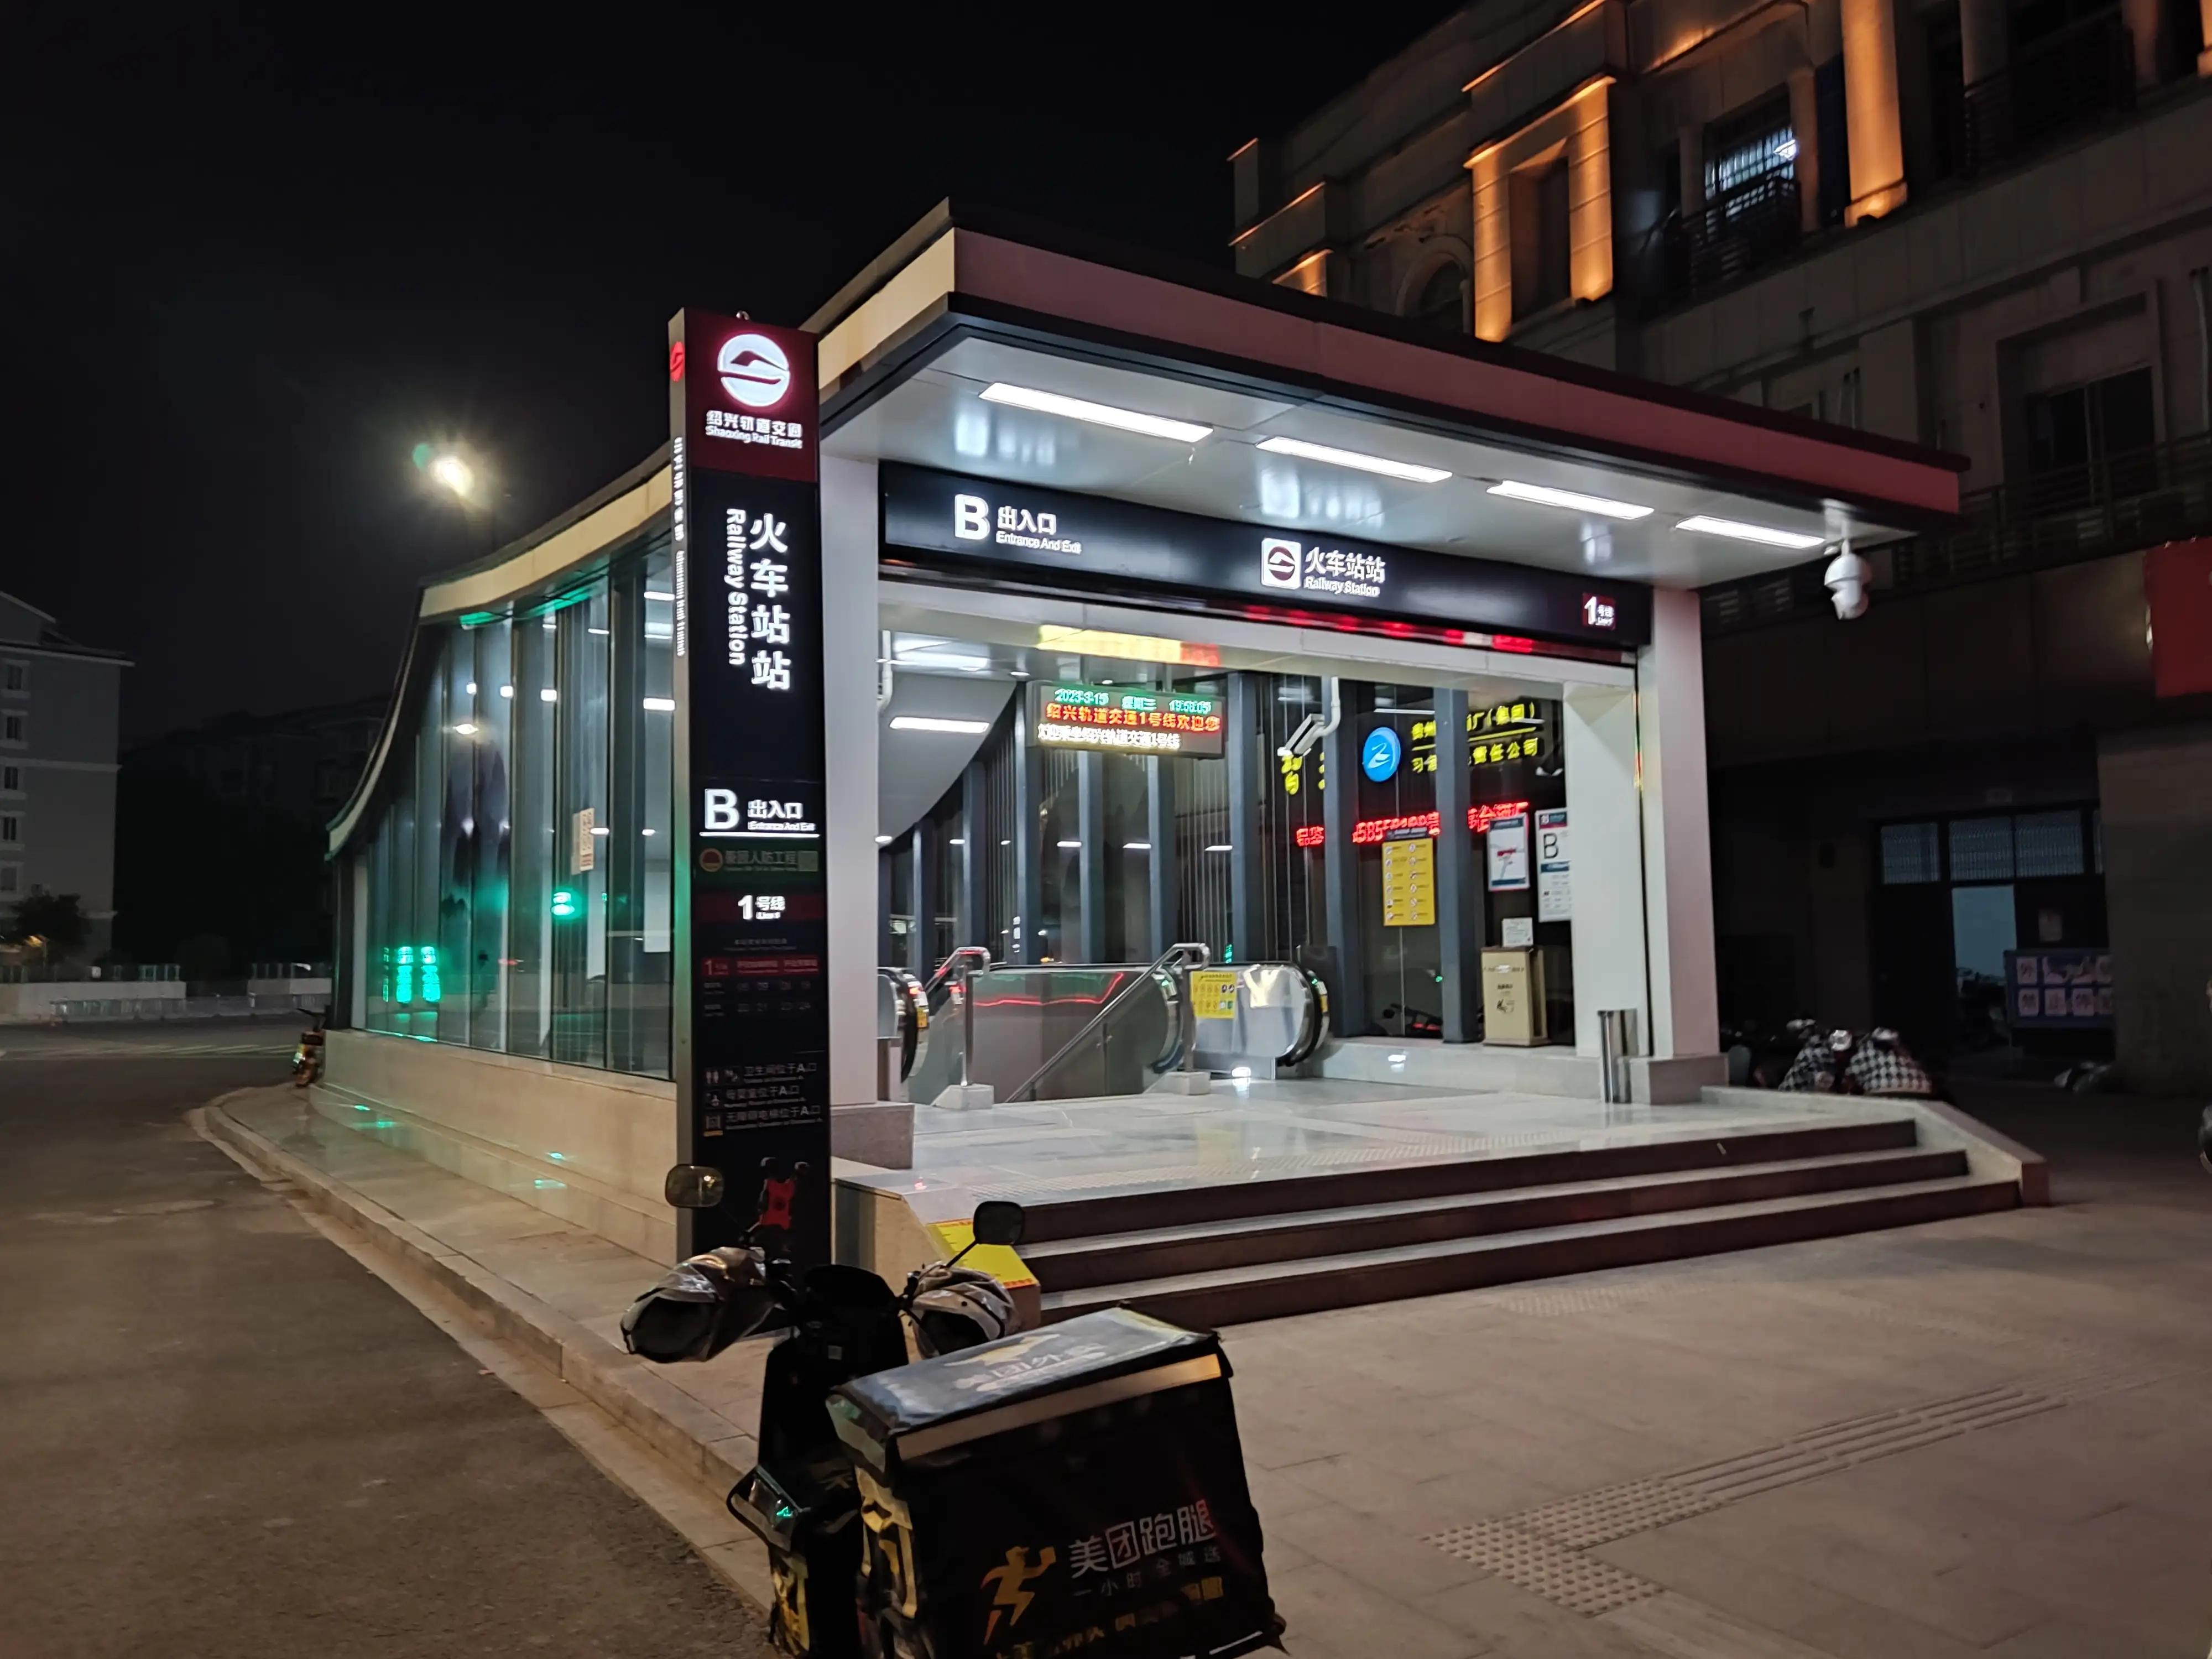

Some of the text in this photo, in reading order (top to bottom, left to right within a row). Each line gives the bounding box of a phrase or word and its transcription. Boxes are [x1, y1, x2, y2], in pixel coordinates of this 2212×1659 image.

[705, 425, 802, 448] Shaoxing Rail Transit
[954, 494, 990, 540] B
[997, 505, 1057, 535] 出入口
[996, 531, 1082, 555] Entrance And Exit
[1304, 546, 1386, 583] 火车站站
[724, 508, 749, 665] Railway Station
[749, 513, 792, 690] 火车站站
[1303, 576, 1381, 598] Railway Station
[1054, 688, 1109, 706] 2023-3-15
[1045, 702, 1221, 732] 绍兴轨道交通1号线欢迎您
[705, 788, 740, 830] B
[748, 799, 804, 819] 出入口
[1543, 832, 1559, 859] B
[954, 1343, 1108, 1389] 团外
[1068, 1499, 1215, 1579] 美团跑腿
